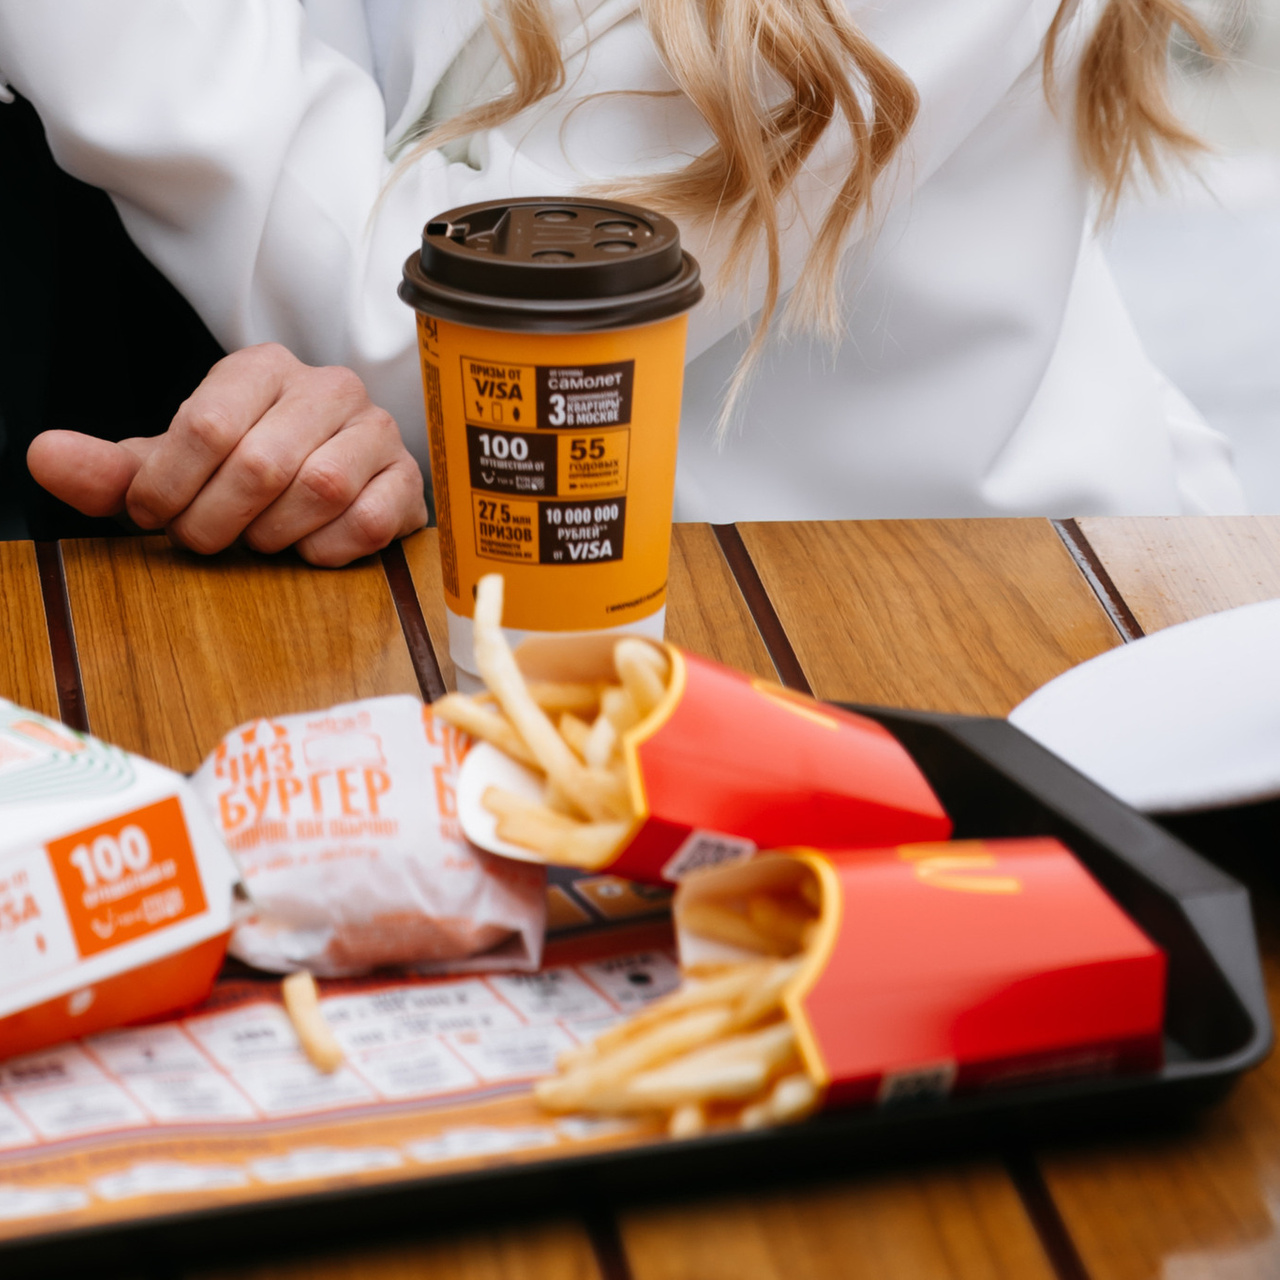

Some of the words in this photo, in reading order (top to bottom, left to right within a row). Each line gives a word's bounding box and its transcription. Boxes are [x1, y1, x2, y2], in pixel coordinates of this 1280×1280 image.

[470, 363, 506, 380] ПРИЗЫ
[509, 369, 522, 381] ОТ
[548, 372, 623, 391] самолет
[472, 377, 523, 402] VISA
[548, 393, 566, 426] 3
[576, 411, 620, 426] МОСКВЕ
[479, 433, 529, 461] 100
[570, 438, 606, 461] 55
[479, 499, 510, 525] 27,5
[546, 508, 562, 525] 10
[565, 507, 591, 525] 000
[594, 503, 619, 521] 000
[479, 522, 532, 542] ПРИЗОВ
[567, 539, 612, 561] VISA
[218, 766, 392, 833] БУРГЕР
[69, 824, 151, 887] 100
